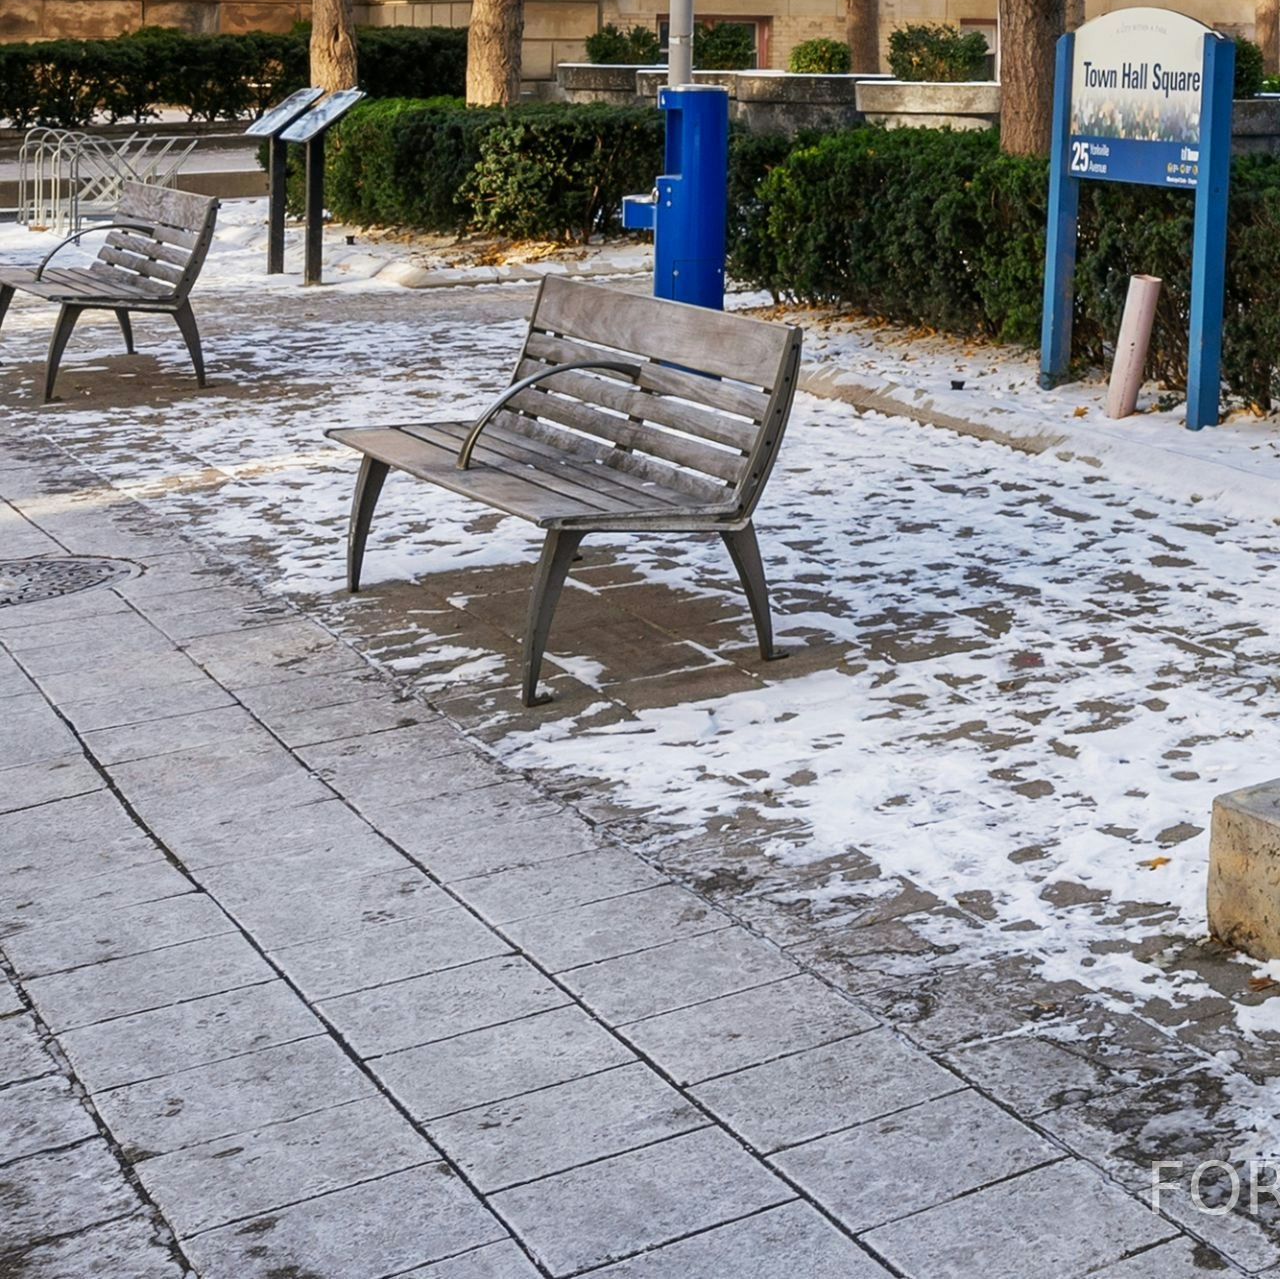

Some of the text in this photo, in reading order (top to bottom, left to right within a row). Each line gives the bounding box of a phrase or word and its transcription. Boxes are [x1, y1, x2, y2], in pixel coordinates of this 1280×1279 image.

[1083, 61, 1201, 99] Town Hall Square
[1071, 141, 1089, 173] 25
[1088, 160, 1108, 174] Avenue
